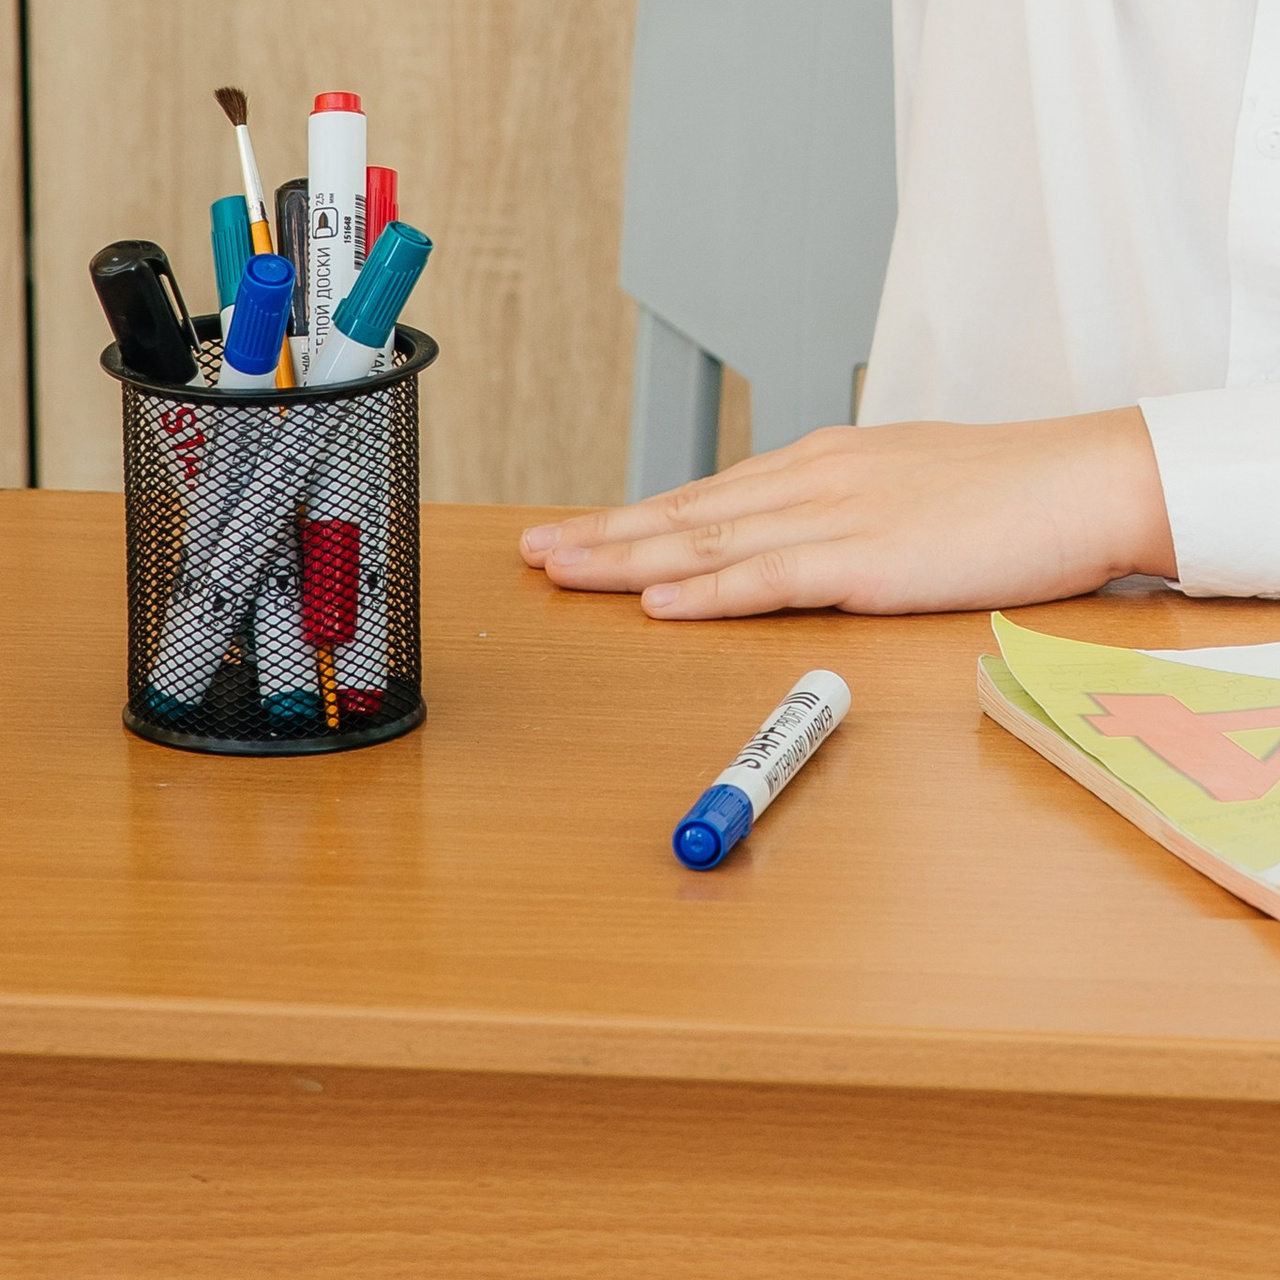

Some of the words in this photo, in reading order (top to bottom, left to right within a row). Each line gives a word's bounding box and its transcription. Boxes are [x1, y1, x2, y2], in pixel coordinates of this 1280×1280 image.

[315, 192, 325, 206] 2,5
[343, 216, 352, 244] 151648
[316, 247, 333, 300] ДОСКИ
[804, 705, 834, 749] MARKER
